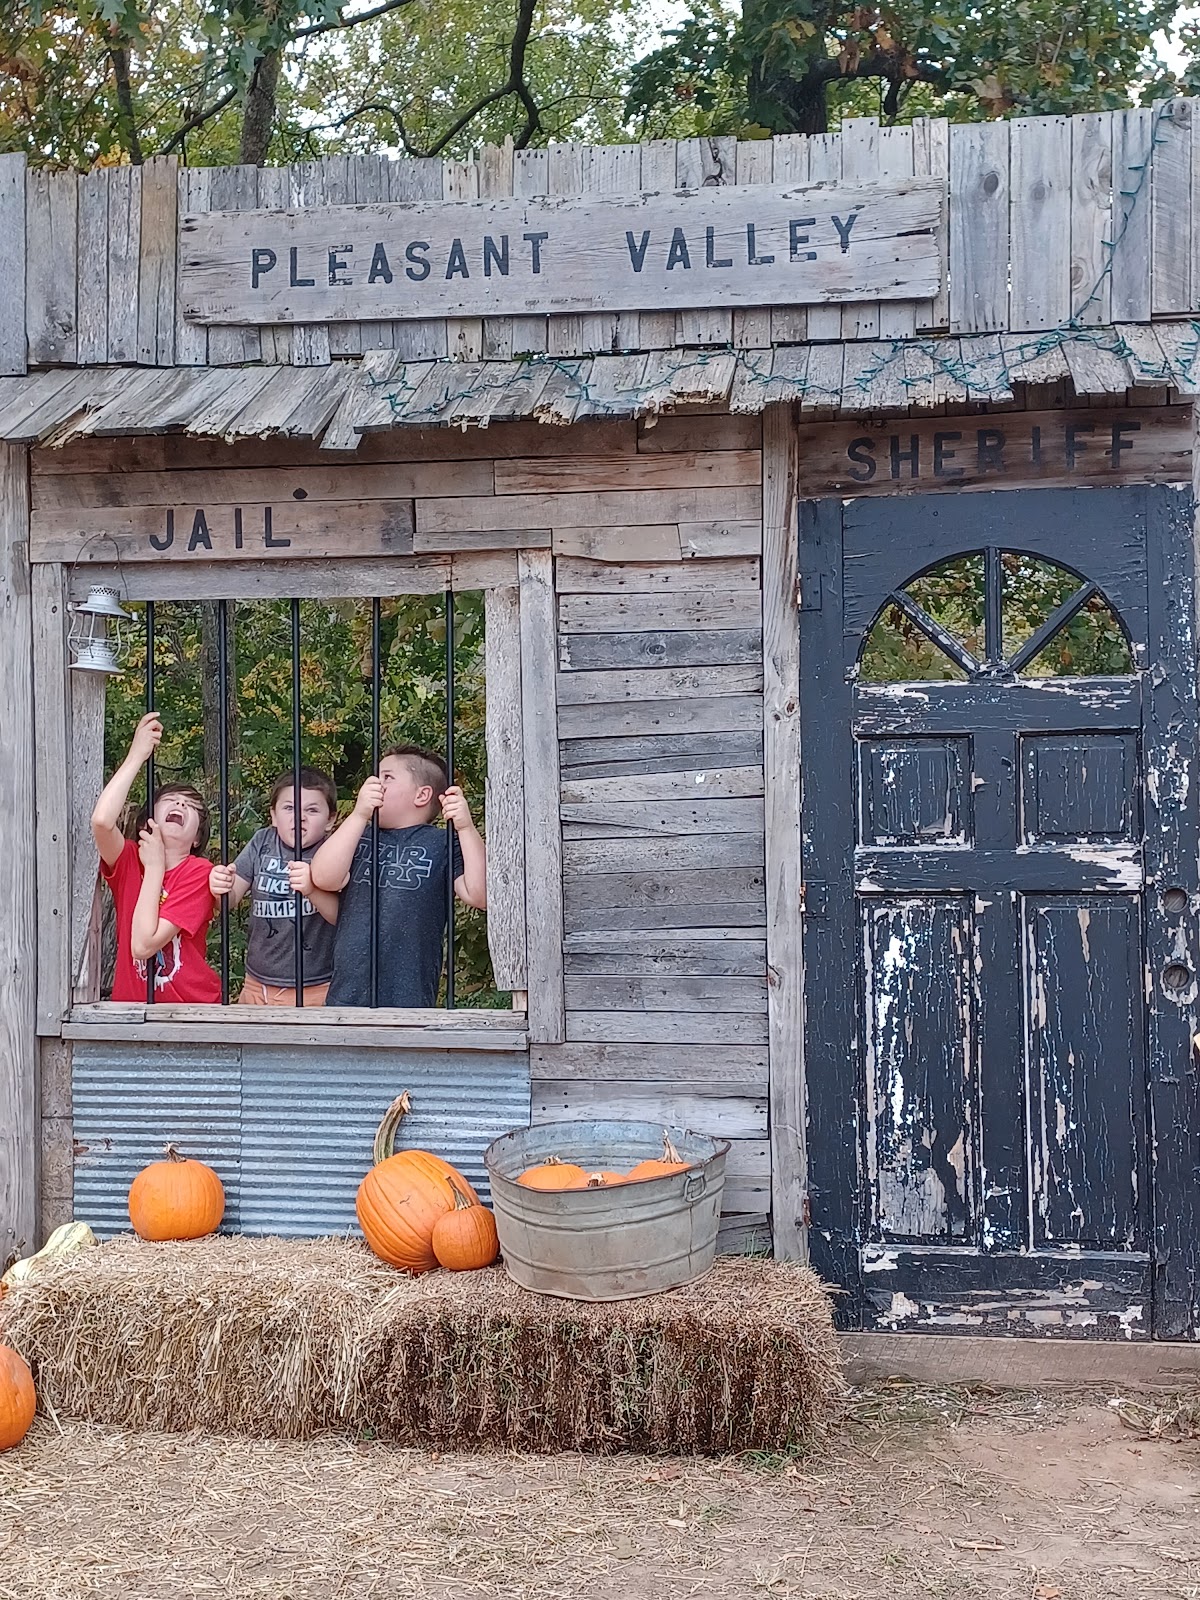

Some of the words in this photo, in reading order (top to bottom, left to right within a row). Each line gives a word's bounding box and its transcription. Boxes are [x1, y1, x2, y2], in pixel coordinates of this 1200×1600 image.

[252, 231, 549, 289] PLEASANT
[625, 213, 858, 273] VALLEY
[847, 421, 1141, 481] SHERIFF
[149, 506, 291, 551] JAIL
[266, 858, 291, 874] PLA
[354, 837, 433, 868] TAR
[257, 876, 290, 895] LIKE
[353, 860, 431, 890] ARS
[254, 901, 318, 916] HAMPO
